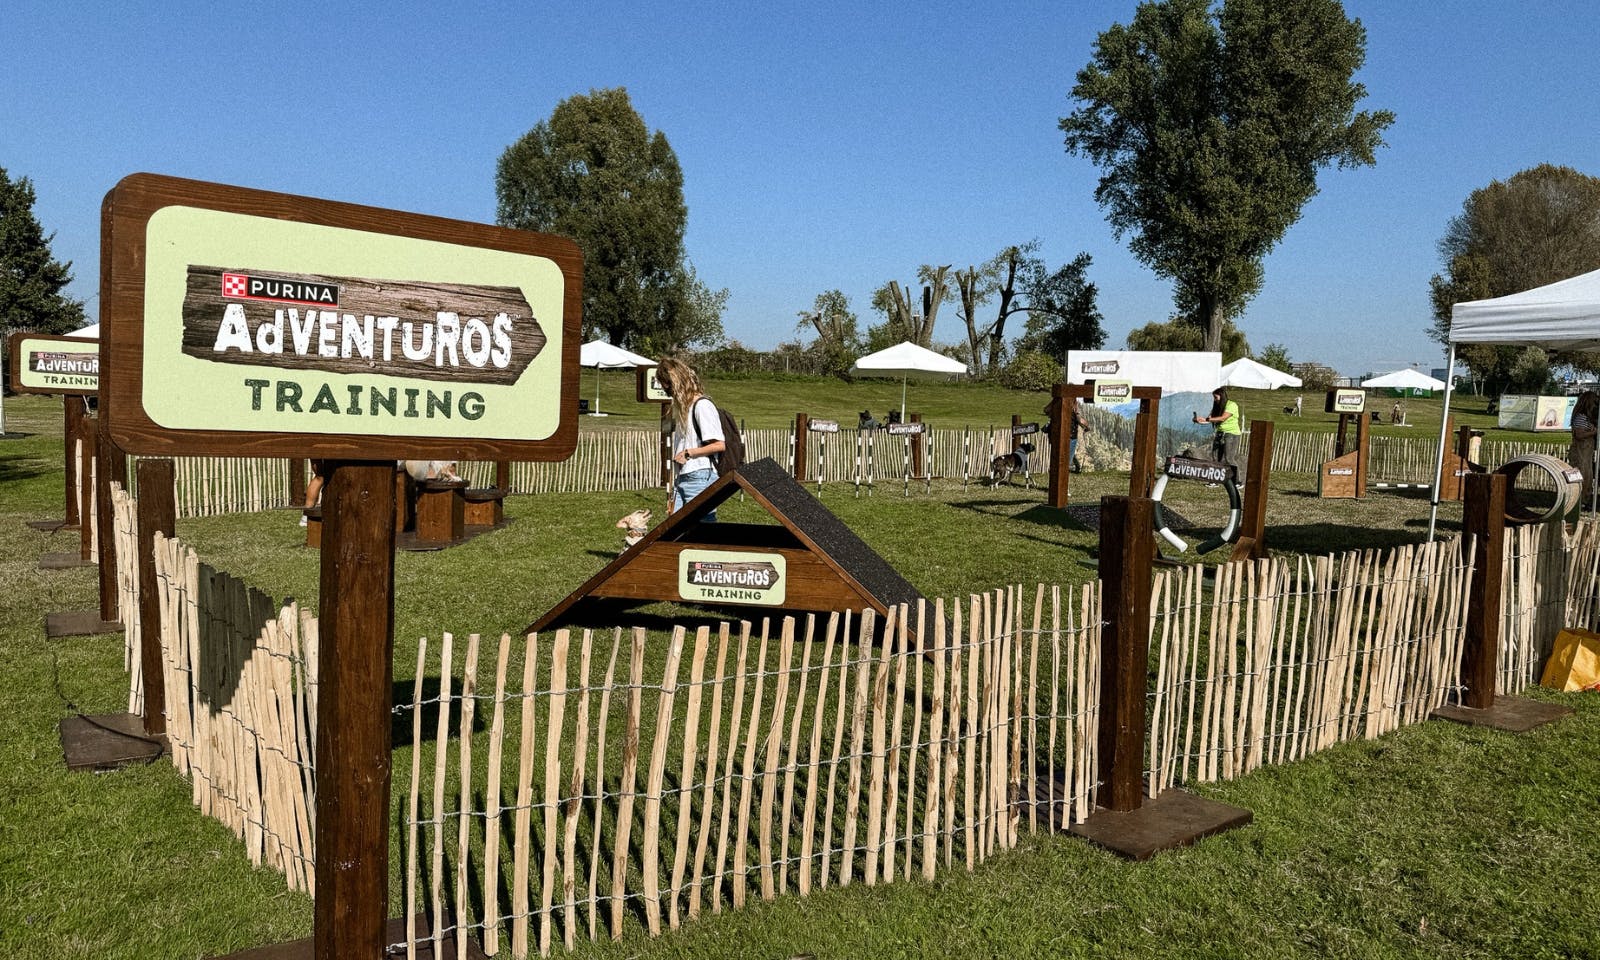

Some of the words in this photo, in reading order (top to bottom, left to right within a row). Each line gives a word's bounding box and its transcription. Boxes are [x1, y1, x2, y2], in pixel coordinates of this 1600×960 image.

[250, 279, 335, 303] PURINA
[44, 375, 98, 385] TRAININ
[244, 377, 487, 421] TRAINING
[700, 588, 762, 601] TRAINING
